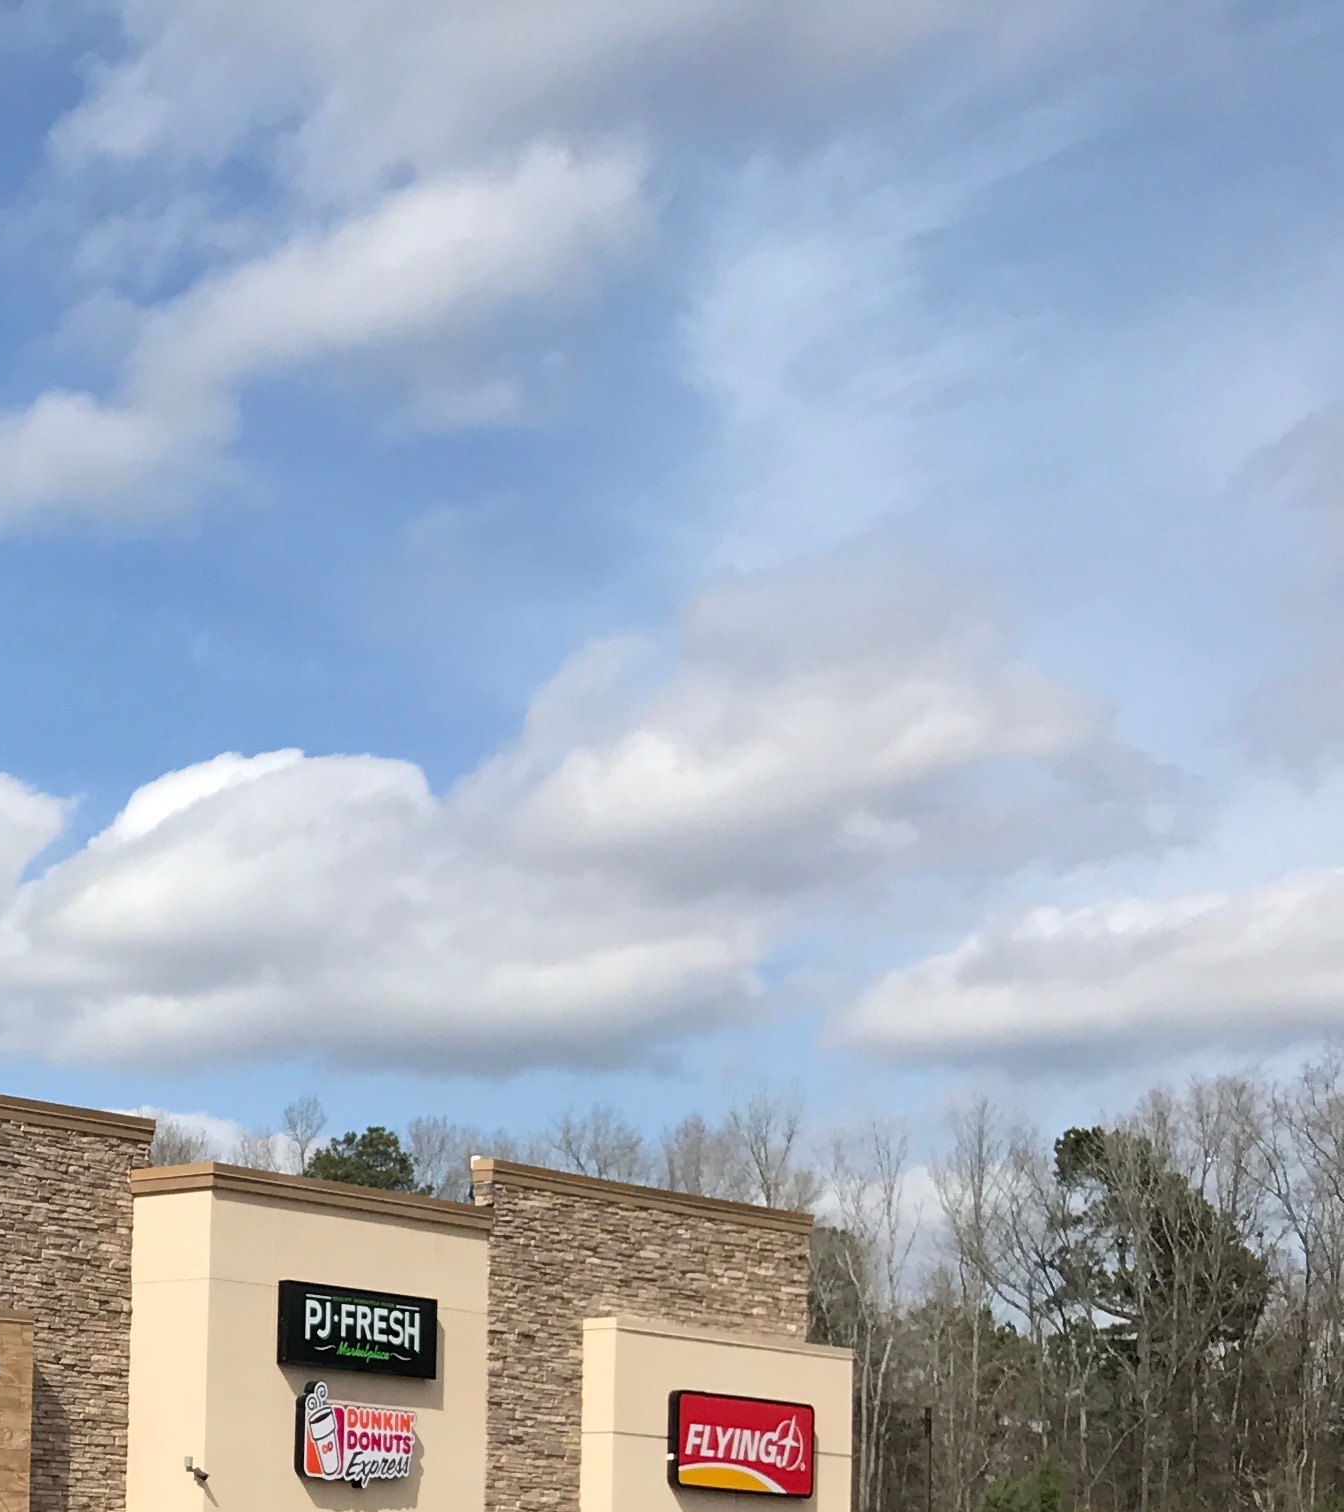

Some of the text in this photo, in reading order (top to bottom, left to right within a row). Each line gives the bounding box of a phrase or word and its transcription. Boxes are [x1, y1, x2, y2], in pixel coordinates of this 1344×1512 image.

[346, 1408, 415, 1433] DUNKIN'
[346, 1430, 412, 1455] DONUTS
[345, 1451, 410, 1484] Express
